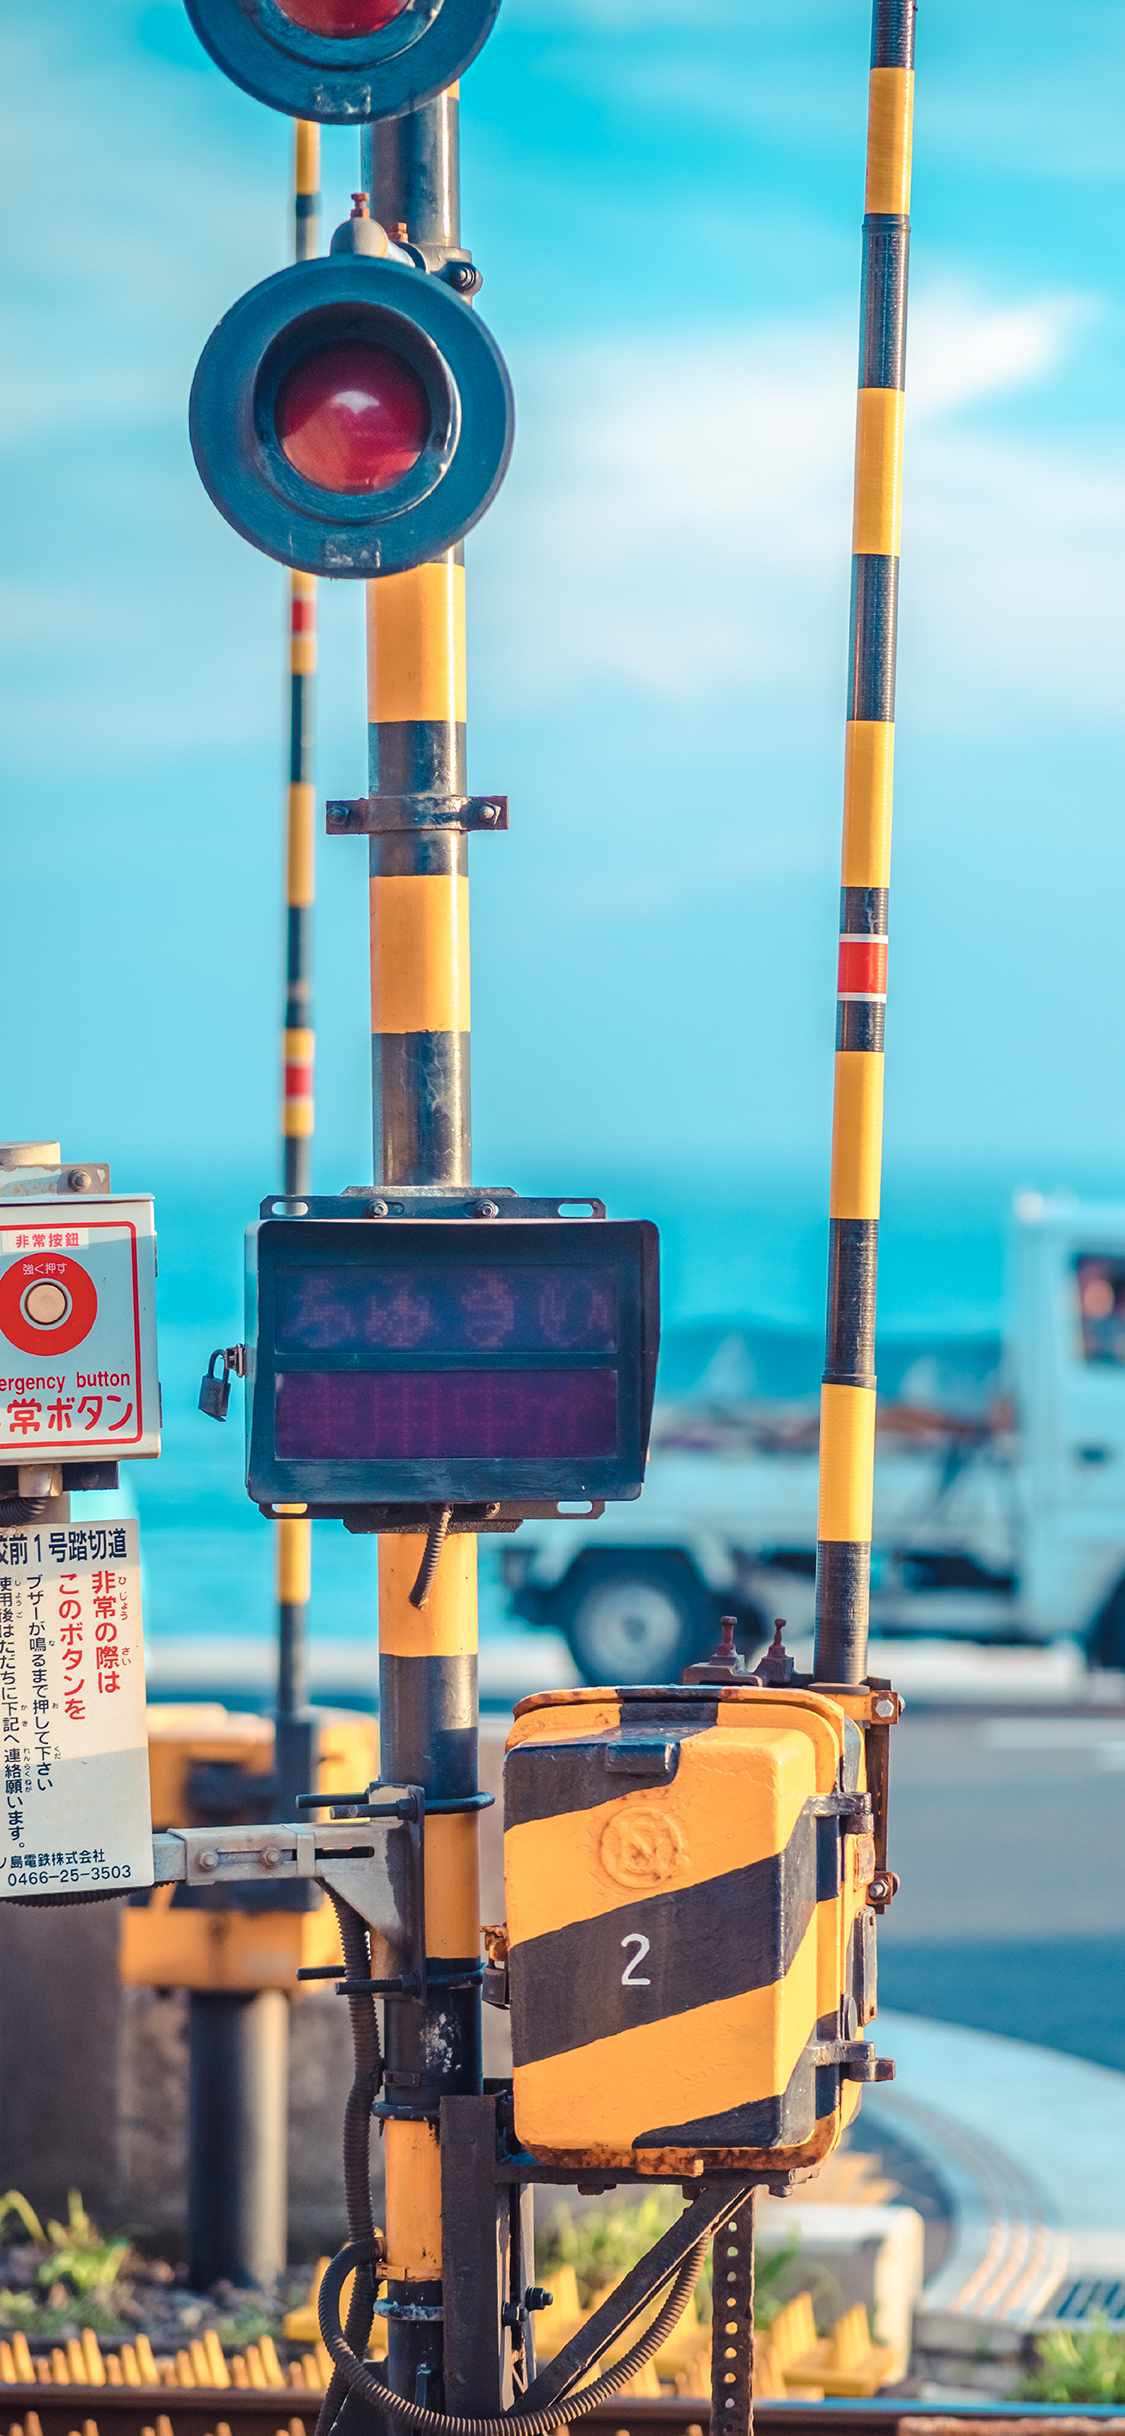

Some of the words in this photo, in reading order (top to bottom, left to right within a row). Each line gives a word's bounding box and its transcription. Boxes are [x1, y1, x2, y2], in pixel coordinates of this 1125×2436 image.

[15, 1232, 80, 1249] 非常按鈕
[23, 1262, 68, 1276] 強く押す
[76, 1371, 131, 1389] button
[0, 1395, 133, 1435] 常ボタン
[58, 1573, 86, 1720] このボタンを
[92, 1570, 121, 1694] 非常の際は
[121, 1647, 132, 1666] さい
[27, 1574, 54, 1792] ブザーが鳴るまで押して下さい
[7, 1864, 132, 1887] 0466-25-3503
[620, 1933, 651, 1985] 2
